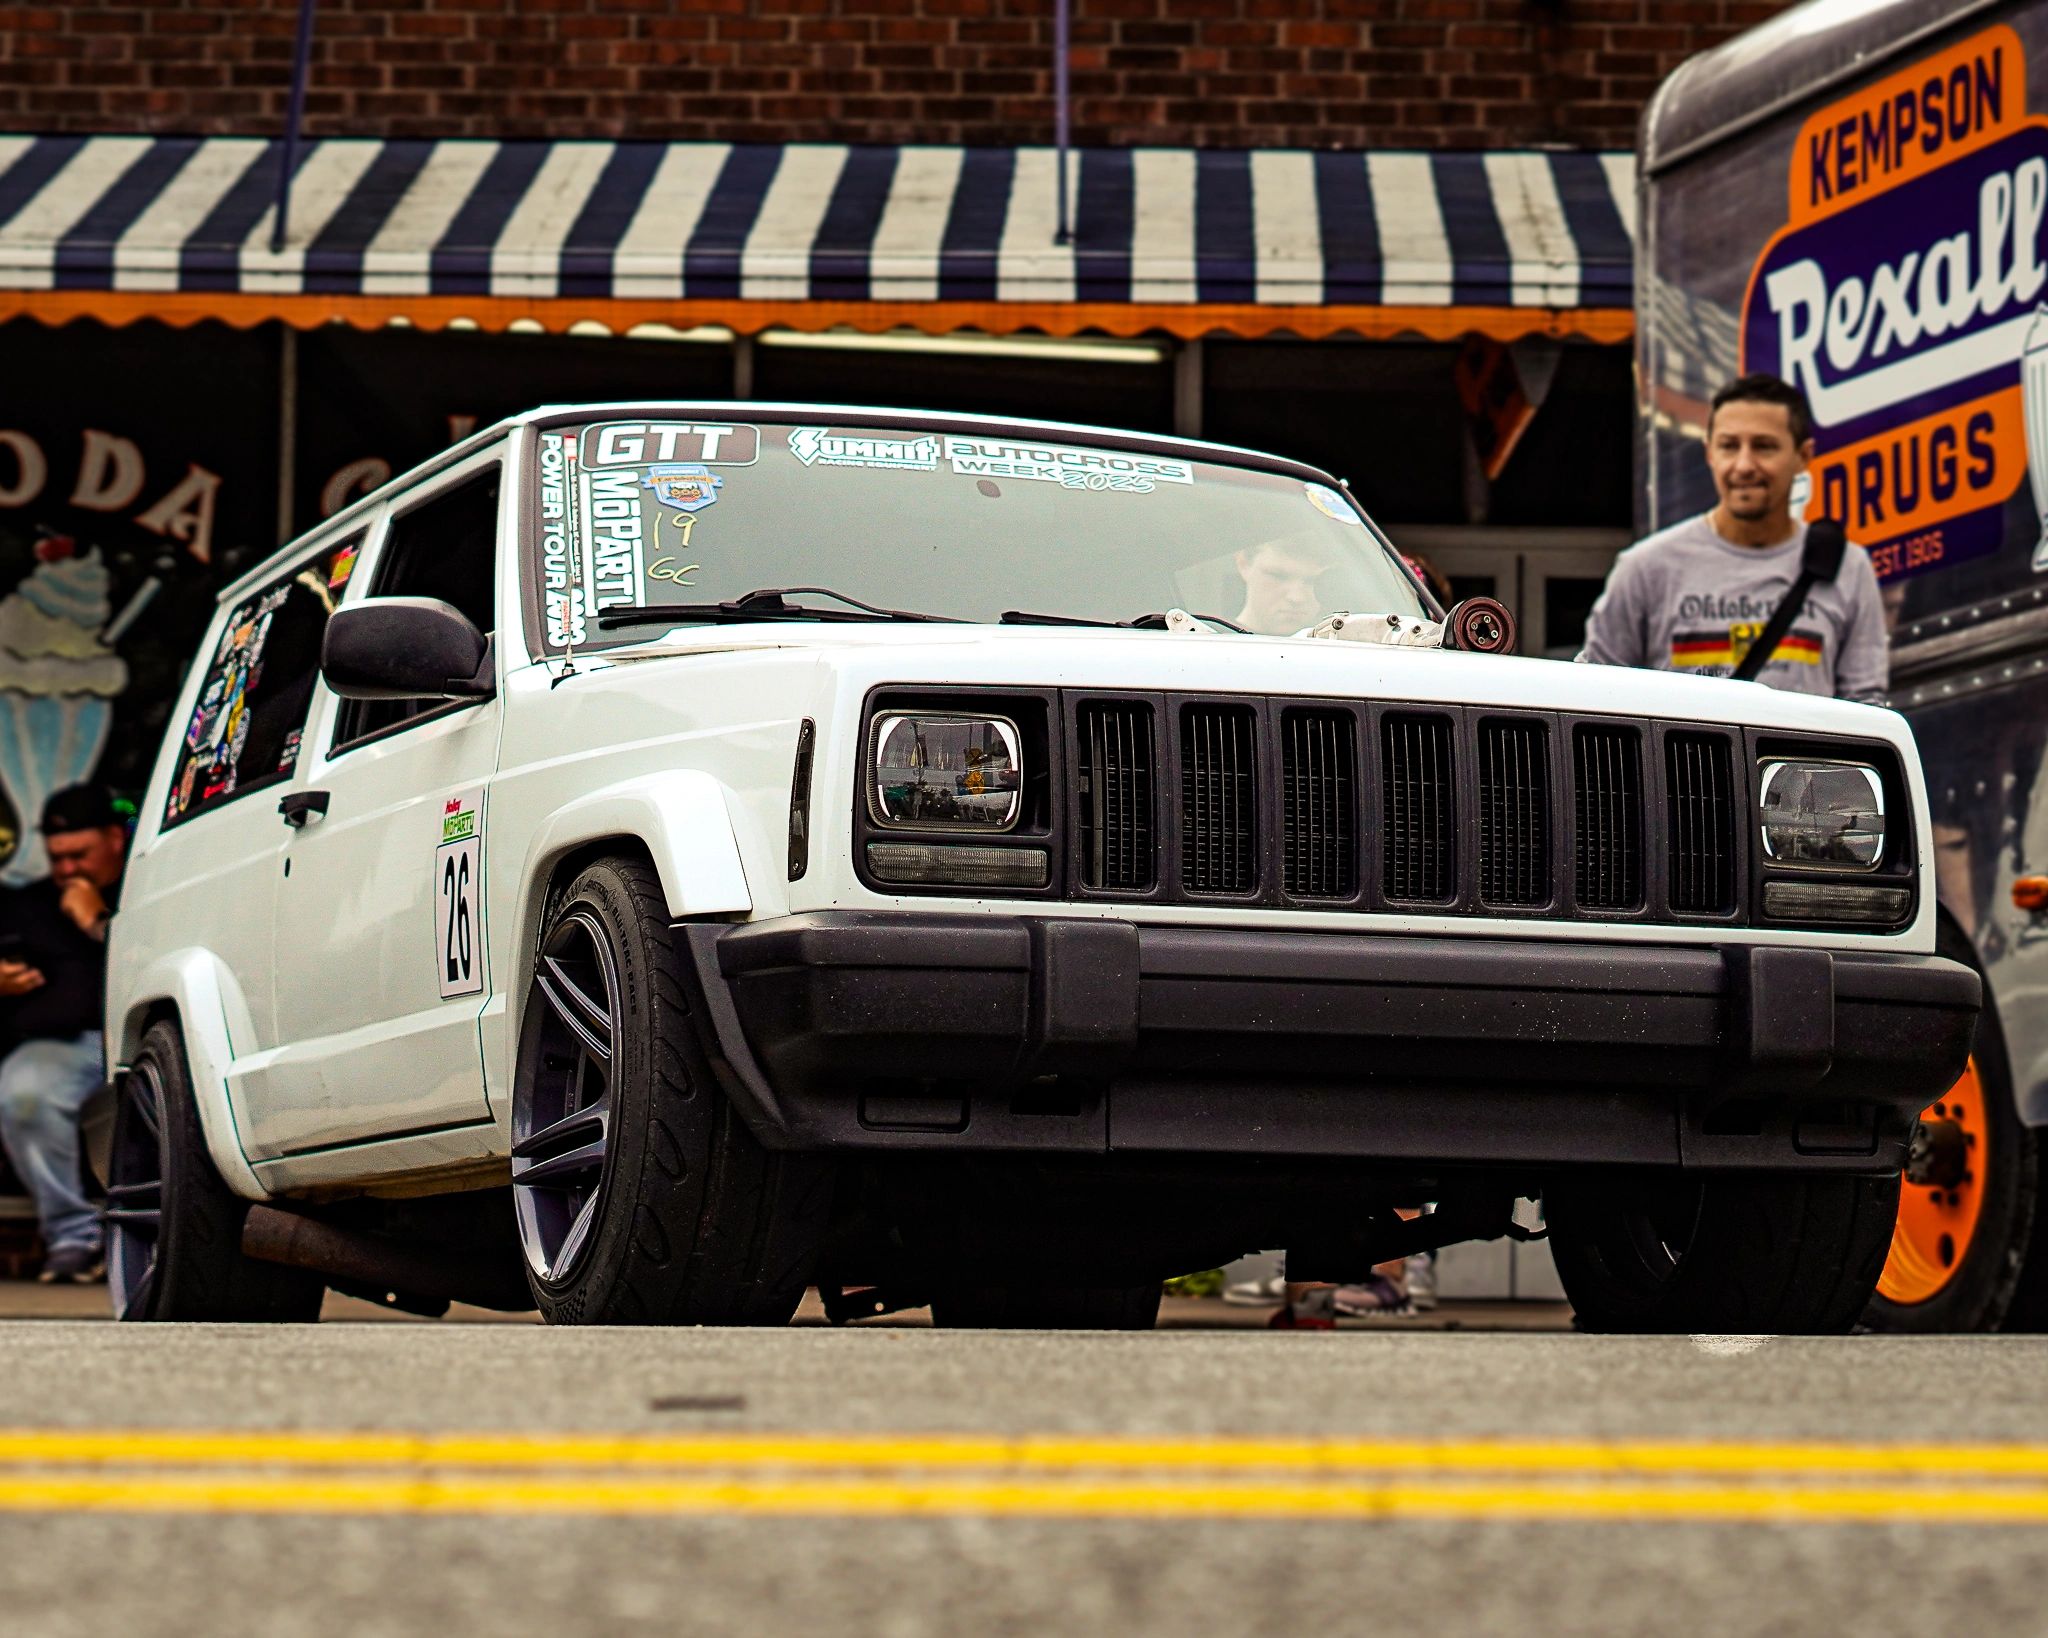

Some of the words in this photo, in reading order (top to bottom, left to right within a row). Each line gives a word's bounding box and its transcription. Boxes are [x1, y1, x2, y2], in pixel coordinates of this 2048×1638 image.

[1810, 47, 2003, 207] KEMPSON
[1765, 155, 2048, 405] Rexall
[541, 435, 564, 519] POWER
[597, 425, 734, 464] GTT
[956, 459, 1058, 479] WEEK
[1060, 469, 1156, 493] 2025
[1822, 410, 1996, 530] DRUGS
[543, 522, 566, 588] TOUR
[653, 511, 698, 550] 19
[1871, 544, 1903, 577] EST.
[1906, 531, 1945, 568] 1905
[444, 851, 470, 982] 26
